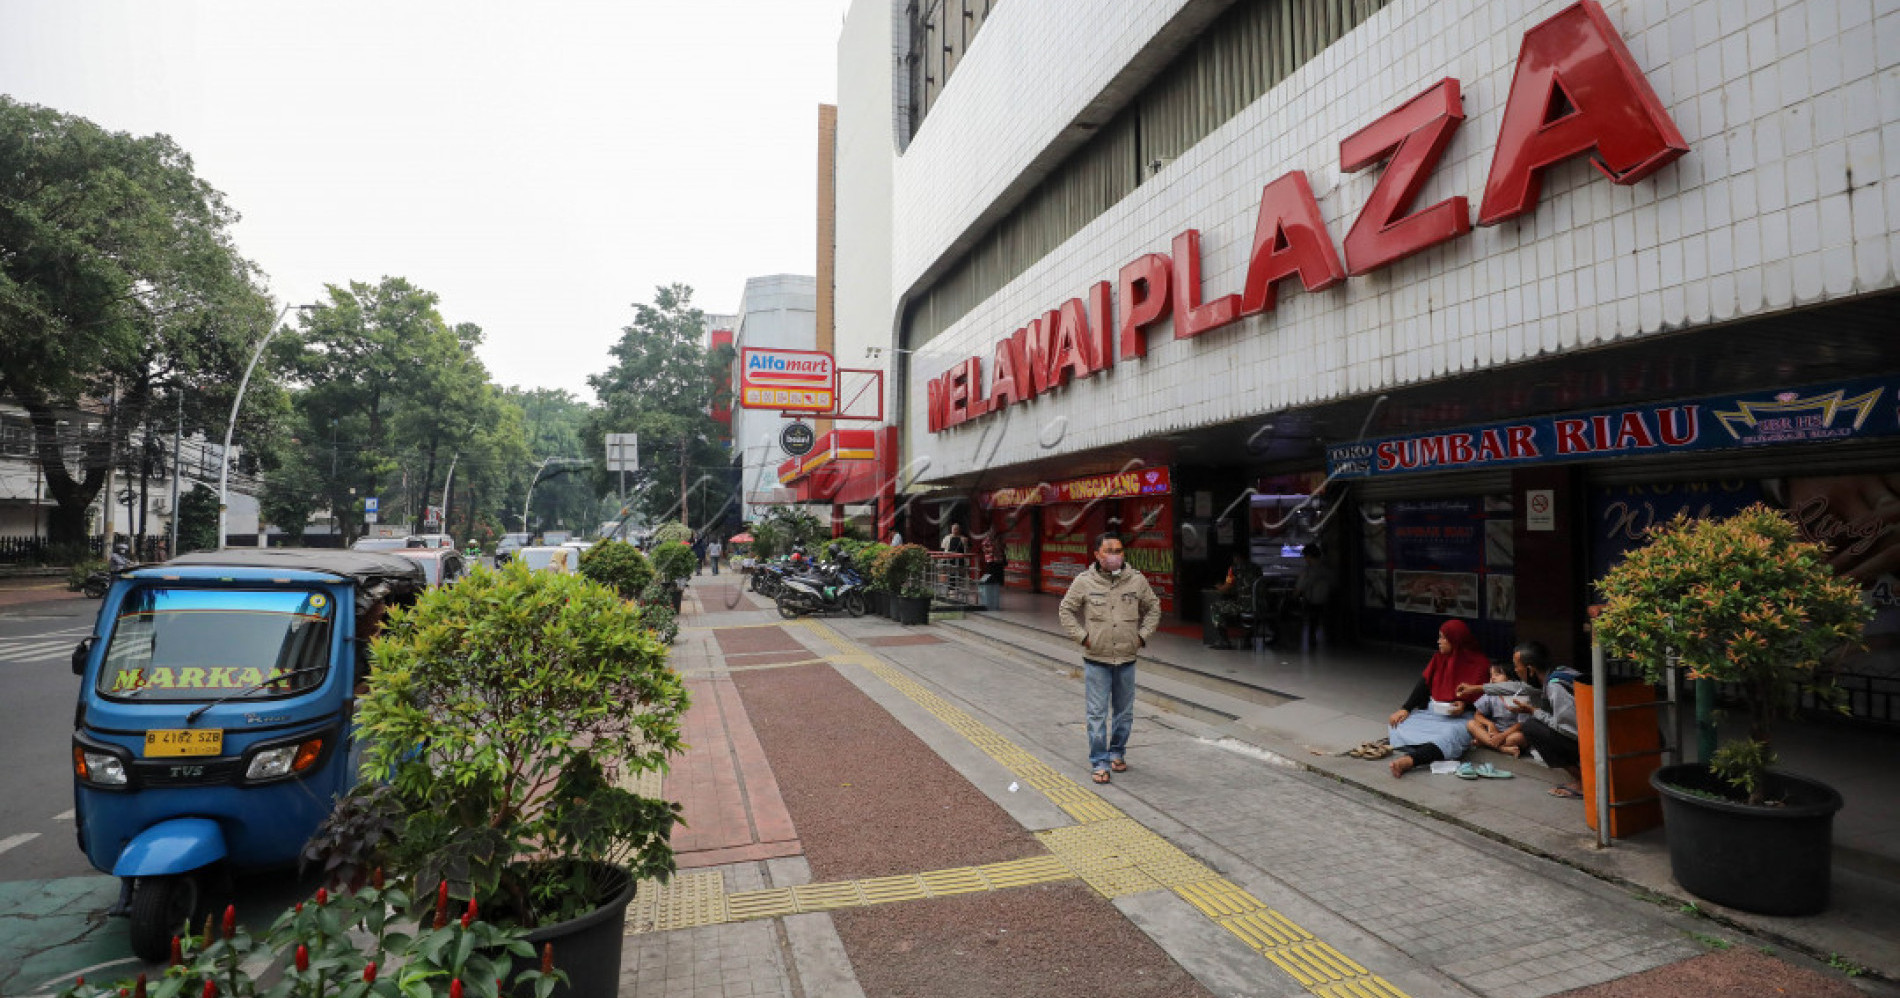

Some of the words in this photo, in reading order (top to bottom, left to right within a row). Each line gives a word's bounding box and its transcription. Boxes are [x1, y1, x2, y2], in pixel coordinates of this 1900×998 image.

[927, 280, 1113, 434] MELAWAI
[1119, 0, 1690, 361] PLAZA
[749, 354, 828, 373] Alfamart
[1376, 425, 1542, 471] SUMBAR
[1555, 404, 1701, 454] RIAU
[170, 765, 205, 778] TVS
